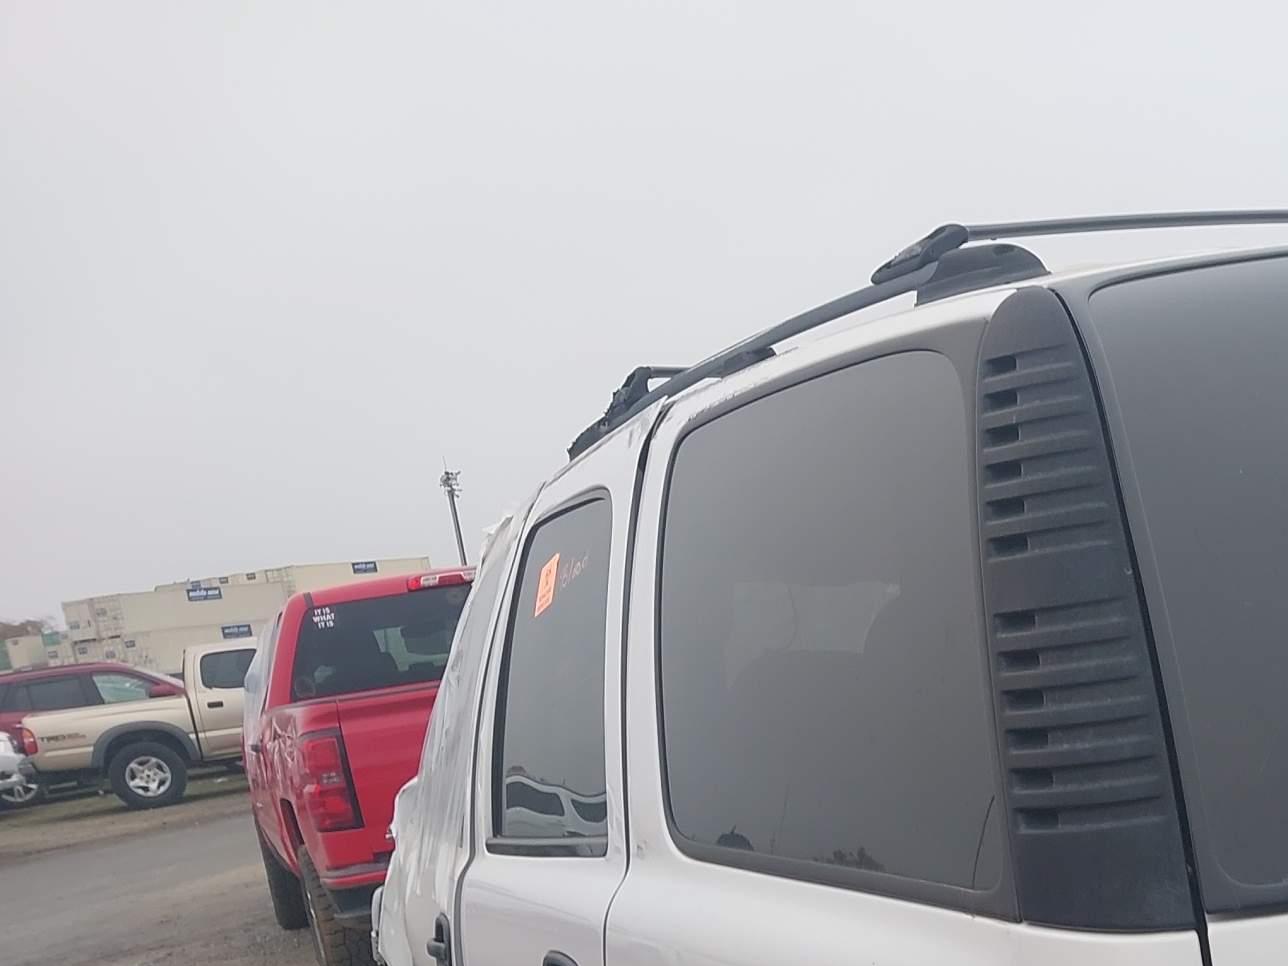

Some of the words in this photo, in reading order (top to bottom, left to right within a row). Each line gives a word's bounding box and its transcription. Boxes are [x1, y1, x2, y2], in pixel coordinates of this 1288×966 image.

[314, 608, 322, 616] IT
[322, 607, 331, 615] IS
[312, 612, 335, 623] WHAT
[326, 620, 334, 628] IS
